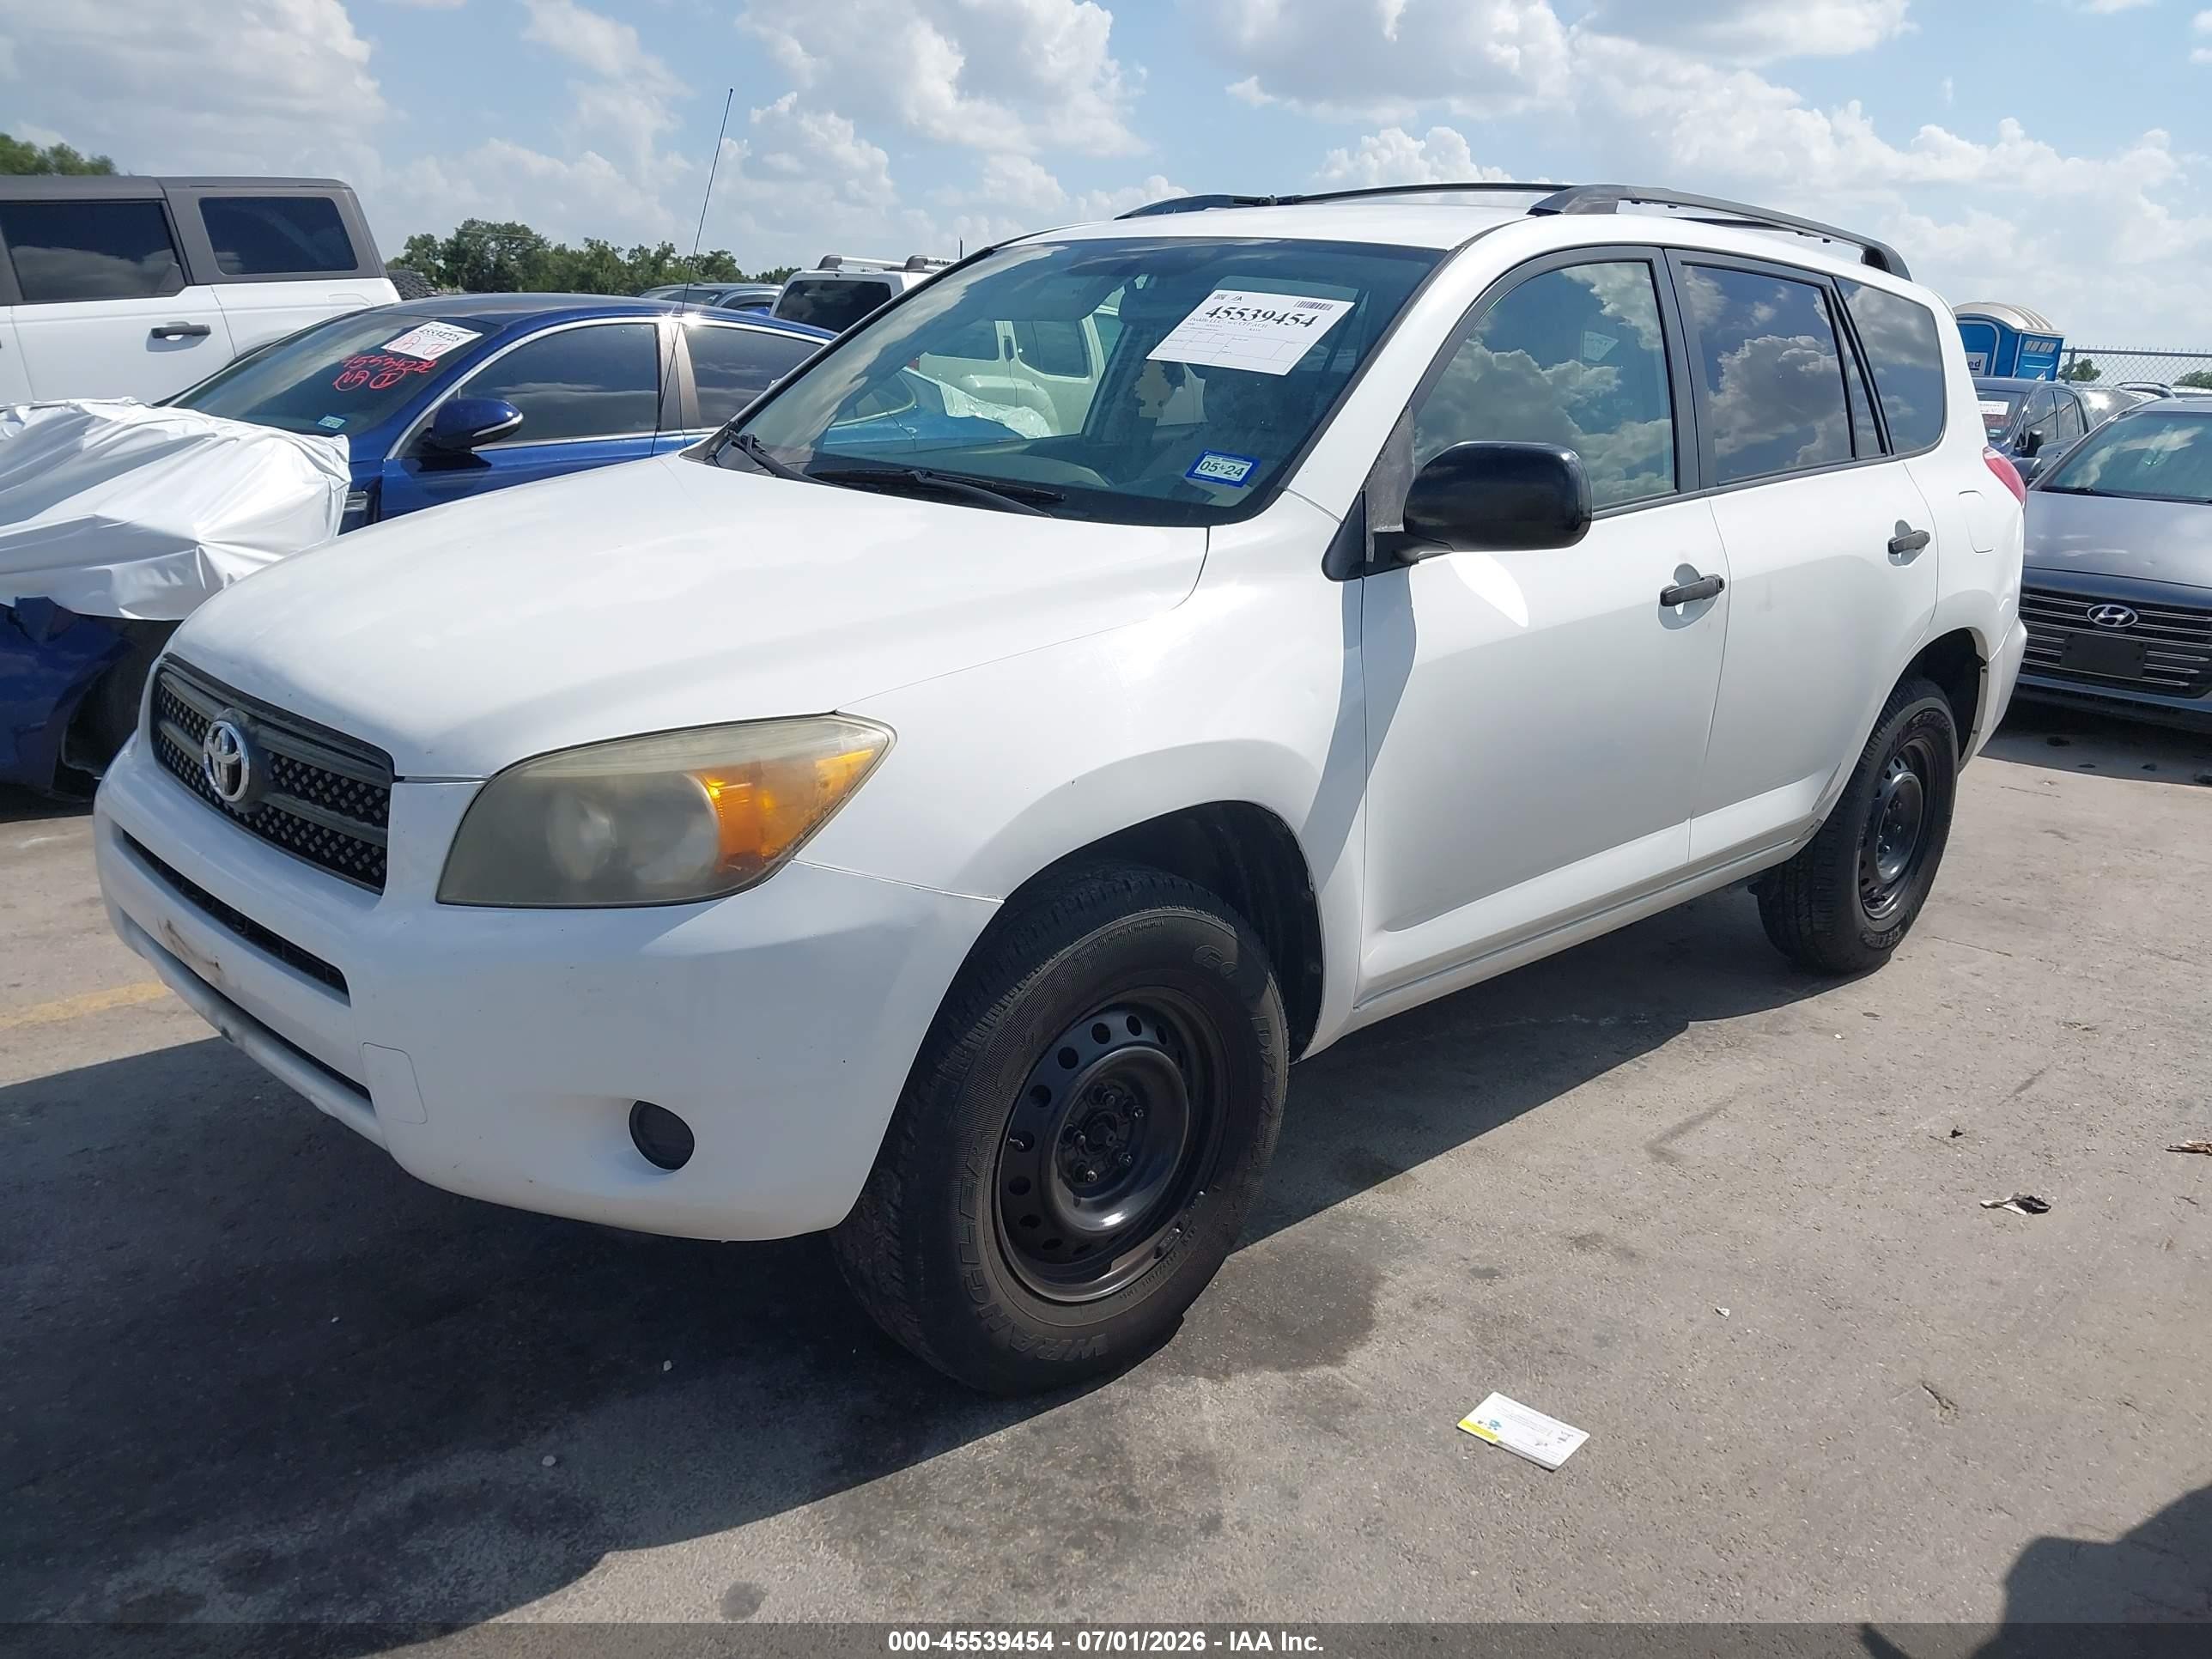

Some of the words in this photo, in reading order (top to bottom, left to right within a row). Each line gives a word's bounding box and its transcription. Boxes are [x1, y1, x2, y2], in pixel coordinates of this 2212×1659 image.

[1205, 305, 1319, 328] 45539454
[1199, 460, 1220, 472] 05
[1223, 465, 1244, 477] 24
